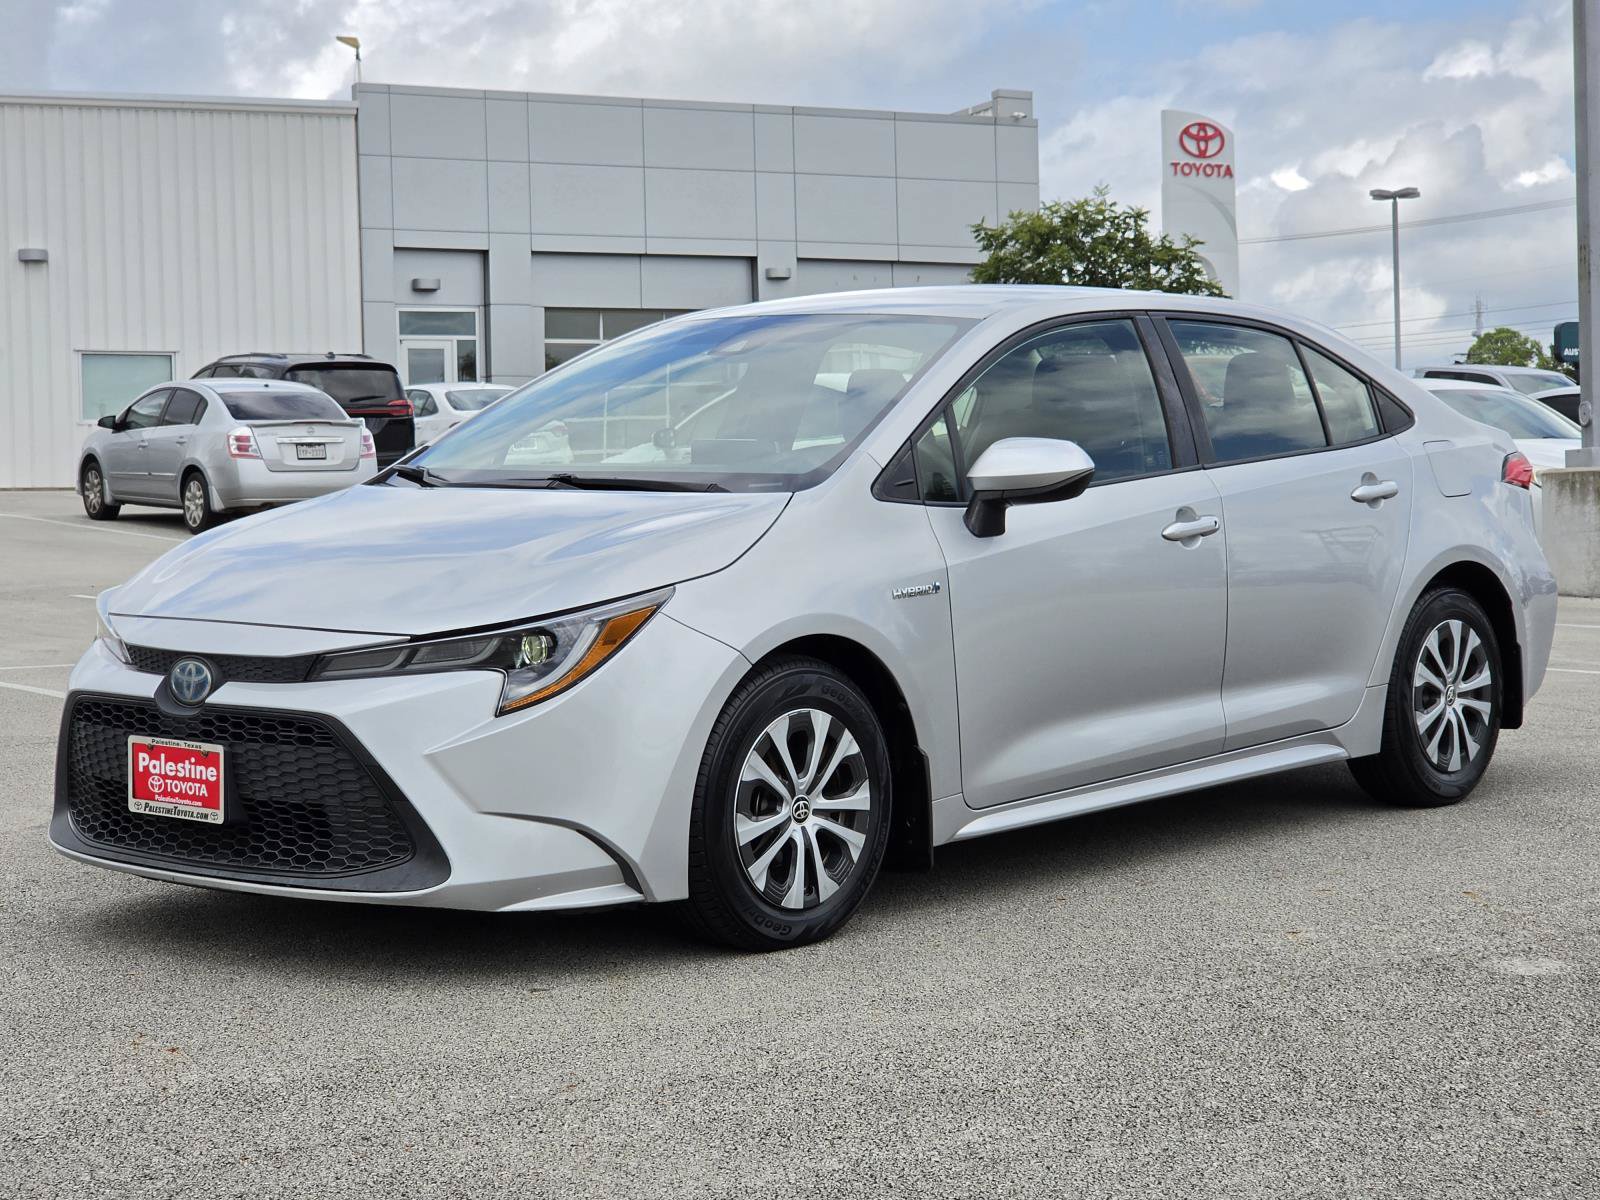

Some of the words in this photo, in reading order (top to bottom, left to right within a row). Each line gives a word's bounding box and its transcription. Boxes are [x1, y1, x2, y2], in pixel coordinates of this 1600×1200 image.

[1170, 162, 1233, 178] TOYOTA
[1563, 348, 1580, 356] AUS
[892, 585, 933, 599] HYBRID
[184, 742, 202, 750] Texas
[138, 752, 217, 781] Palestine
[165, 779, 208, 797] TOYOTA
